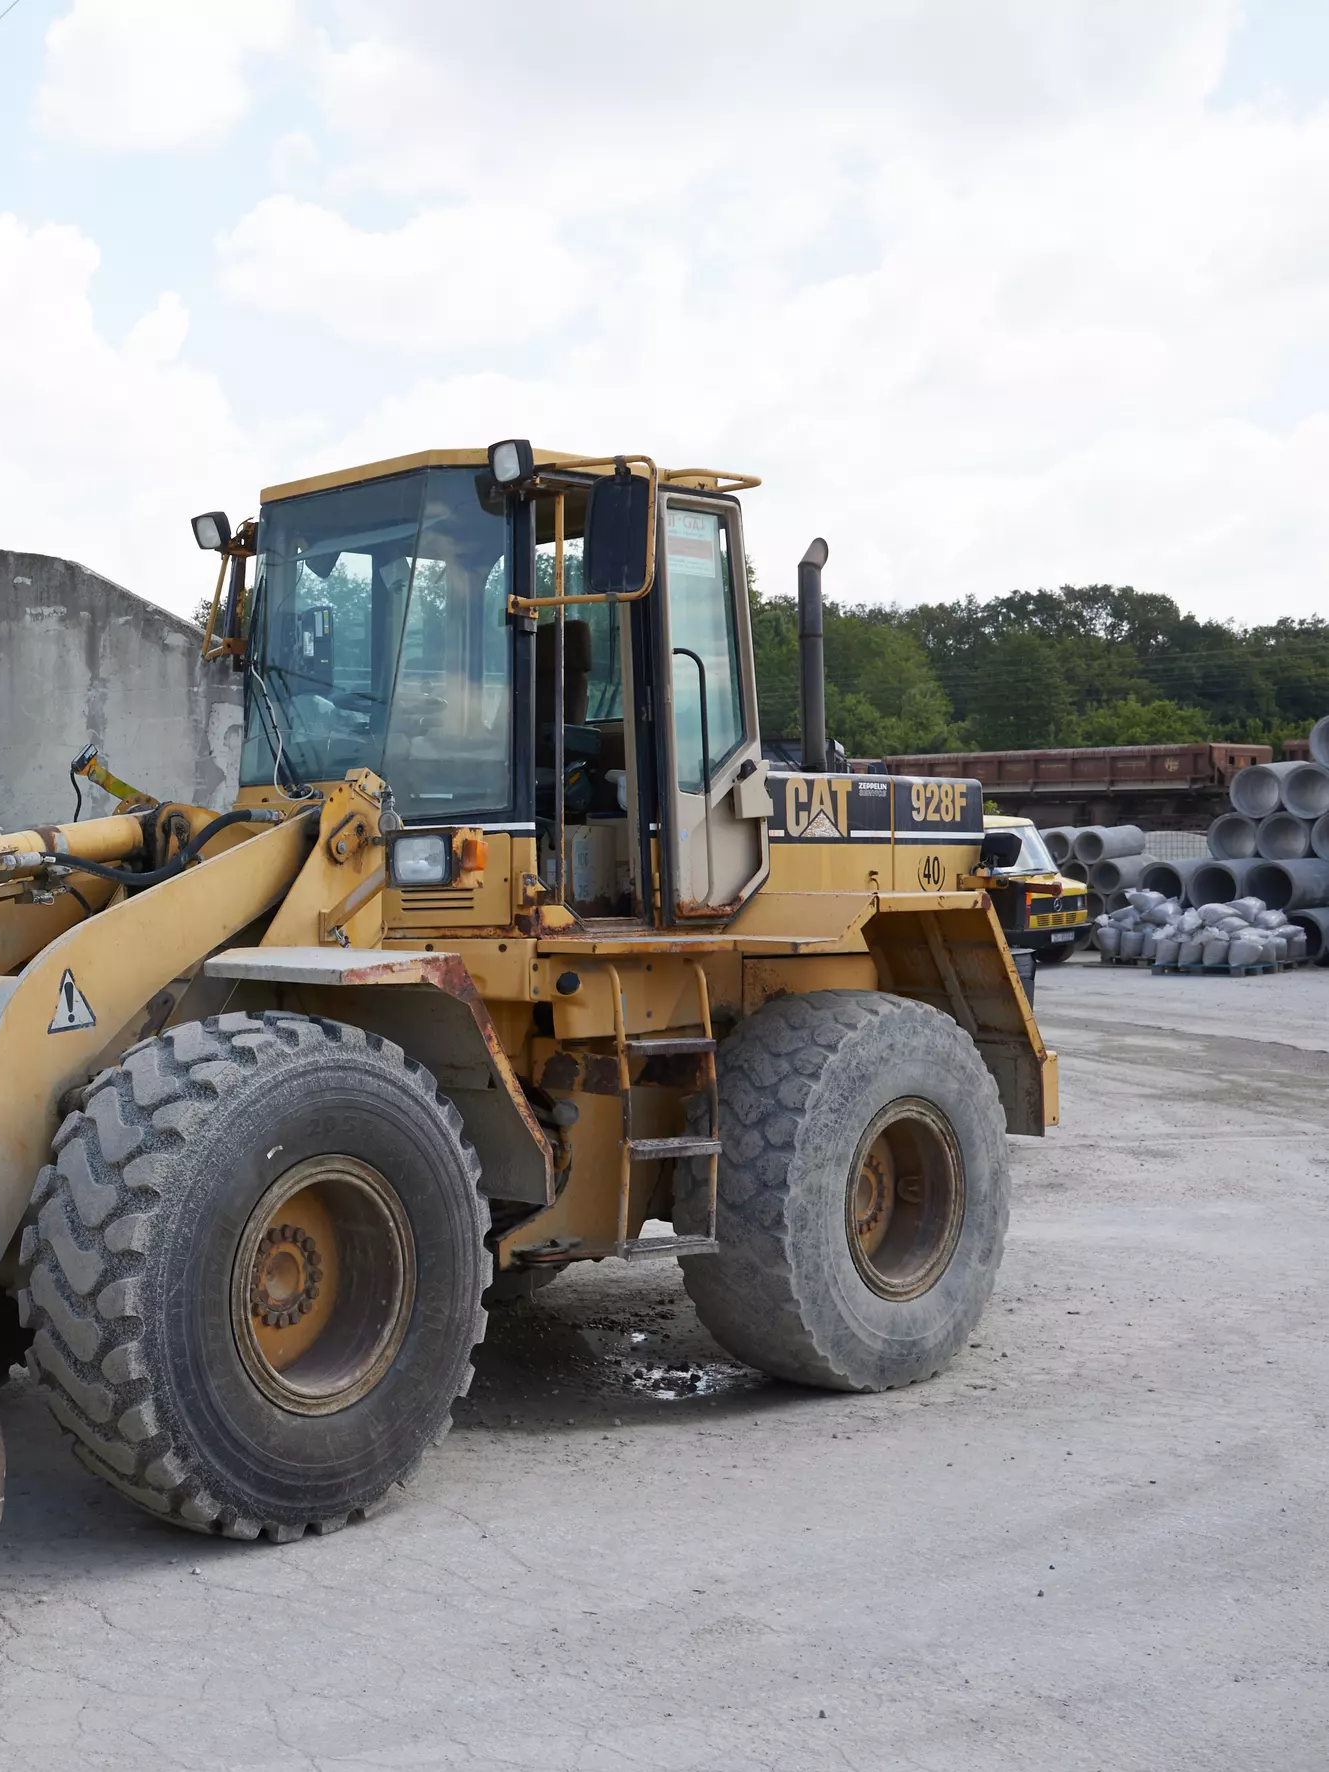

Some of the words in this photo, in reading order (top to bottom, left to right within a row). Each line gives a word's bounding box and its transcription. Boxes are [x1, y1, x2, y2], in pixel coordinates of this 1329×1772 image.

[858, 782, 888, 790] ZEPPELIN
[911, 783, 967, 822] 928F
[785, 777, 852, 837] CAT
[923, 855, 940, 885] 40
